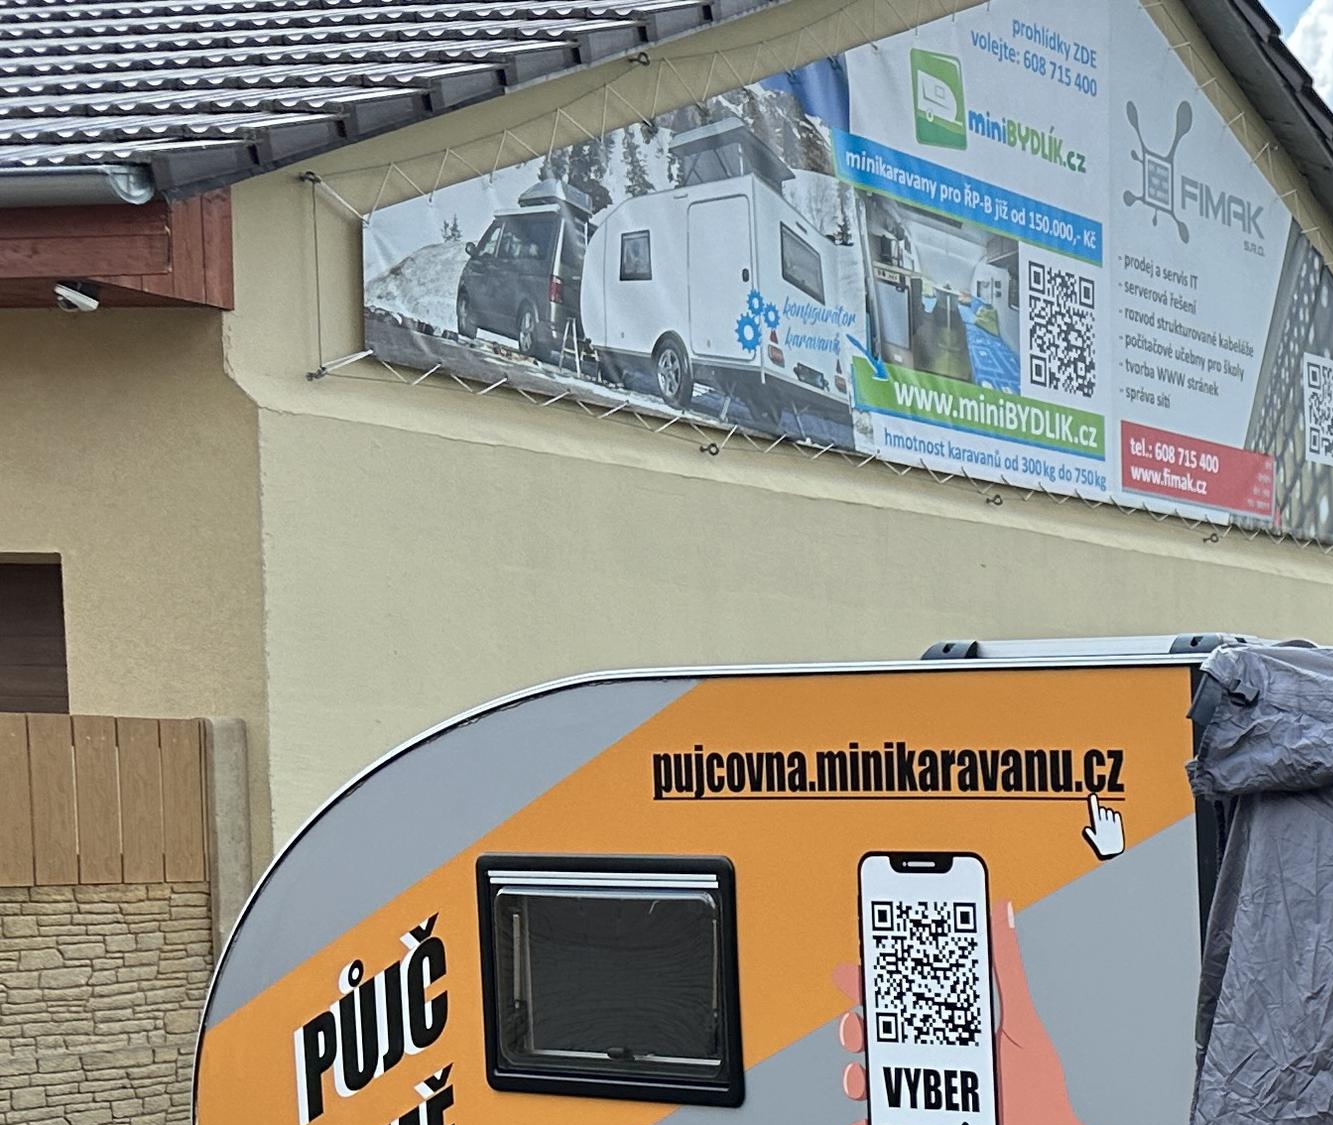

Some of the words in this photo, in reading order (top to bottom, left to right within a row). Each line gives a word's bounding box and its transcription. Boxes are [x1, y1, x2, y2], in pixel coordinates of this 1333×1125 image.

[970, 30, 1020, 65] volejte:
[1023, 50, 1047, 76] 608
[1049, 61, 1072, 87] 715
[1074, 73, 1097, 97] 400
[1012, 19, 1071, 61] prohlídky
[1073, 42, 1097, 69] ZDE
[968, 109, 1086, 173] miniBYDLÍK.cz
[846, 150, 937, 199] minikaravany
[940, 185, 961, 203] pro
[963, 182, 992, 214] ŘP-B
[1011, 207, 1025, 225] od
[1083, 229, 1096, 249] Kč
[1181, 175, 1265, 240] FIMAK
[1124, 254, 1154, 278] prodej
[1155, 265, 1161, 278] a
[1162, 268, 1188, 287] servis
[1189, 274, 1198, 289] IT
[1124, 281, 1168, 306] serverová
[1124, 307, 1155, 327] rozvod
[1157, 317, 1217, 346] strukturované
[1125, 359, 1155, 379] tvorba
[1156, 367, 1186, 387] WWW
[1187, 376, 1219, 397] stránek
[1174, 346, 1206, 371] učebny
[1207, 359, 1222, 373] pro
[893, 381, 1098, 448] www.miniBYDLIK.cz
[1125, 386, 1155, 405] správa
[884, 427, 944, 457] hmotnost
[948, 441, 1001, 468] karavanů
[1004, 455, 1018, 472] od
[1058, 463, 1072, 482] do
[1129, 437, 1153, 458] tel.:
[1155, 442, 1175, 464] 608
[1178, 448, 1197, 469] 715
[1199, 454, 1219, 473] 400
[1130, 465, 1207, 495] www.fimak.cz
[652, 742, 1125, 798] pujcovna.minikaravanu.cz
[882, 1066, 981, 1113] VYBER
